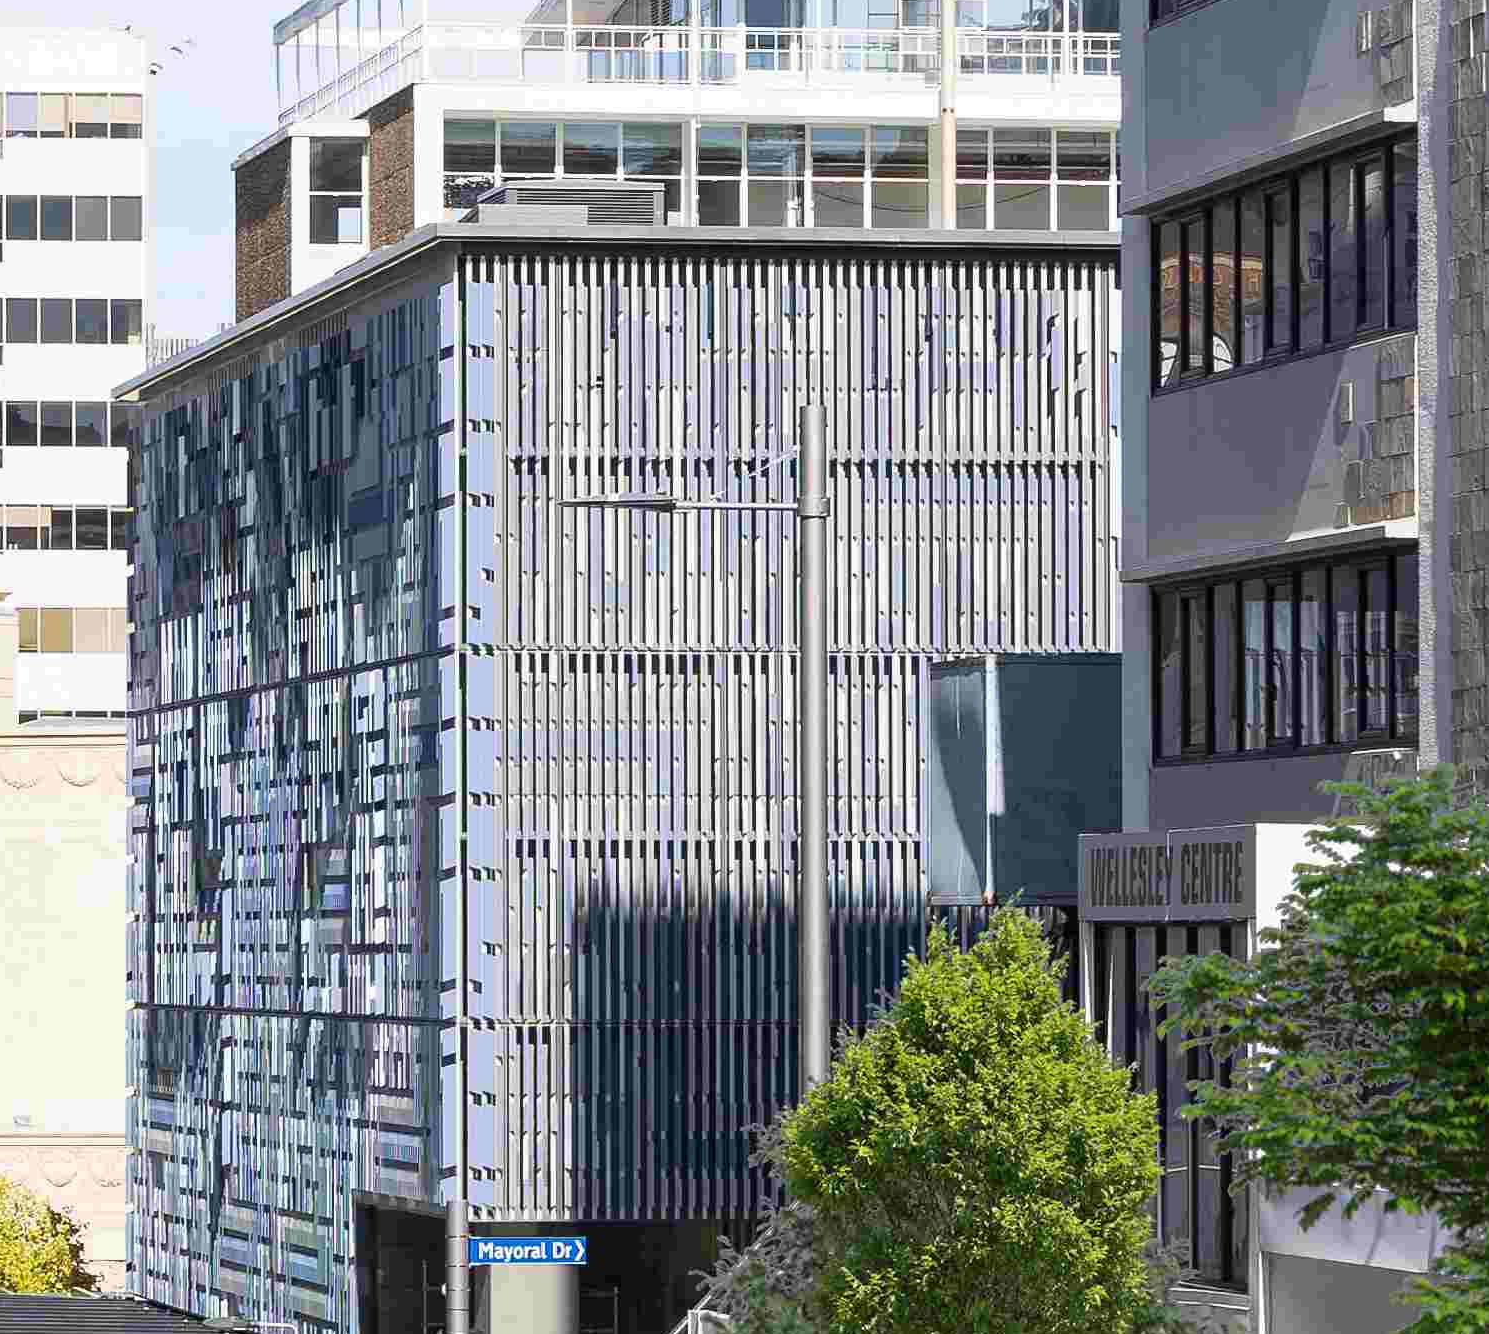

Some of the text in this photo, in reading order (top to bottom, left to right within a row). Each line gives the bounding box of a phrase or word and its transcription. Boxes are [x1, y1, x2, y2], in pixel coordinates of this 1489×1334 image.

[1090, 841, 1243, 907] WELLESLEY CENTRE
[478, 1241, 572, 1262] Mayoral Dr
